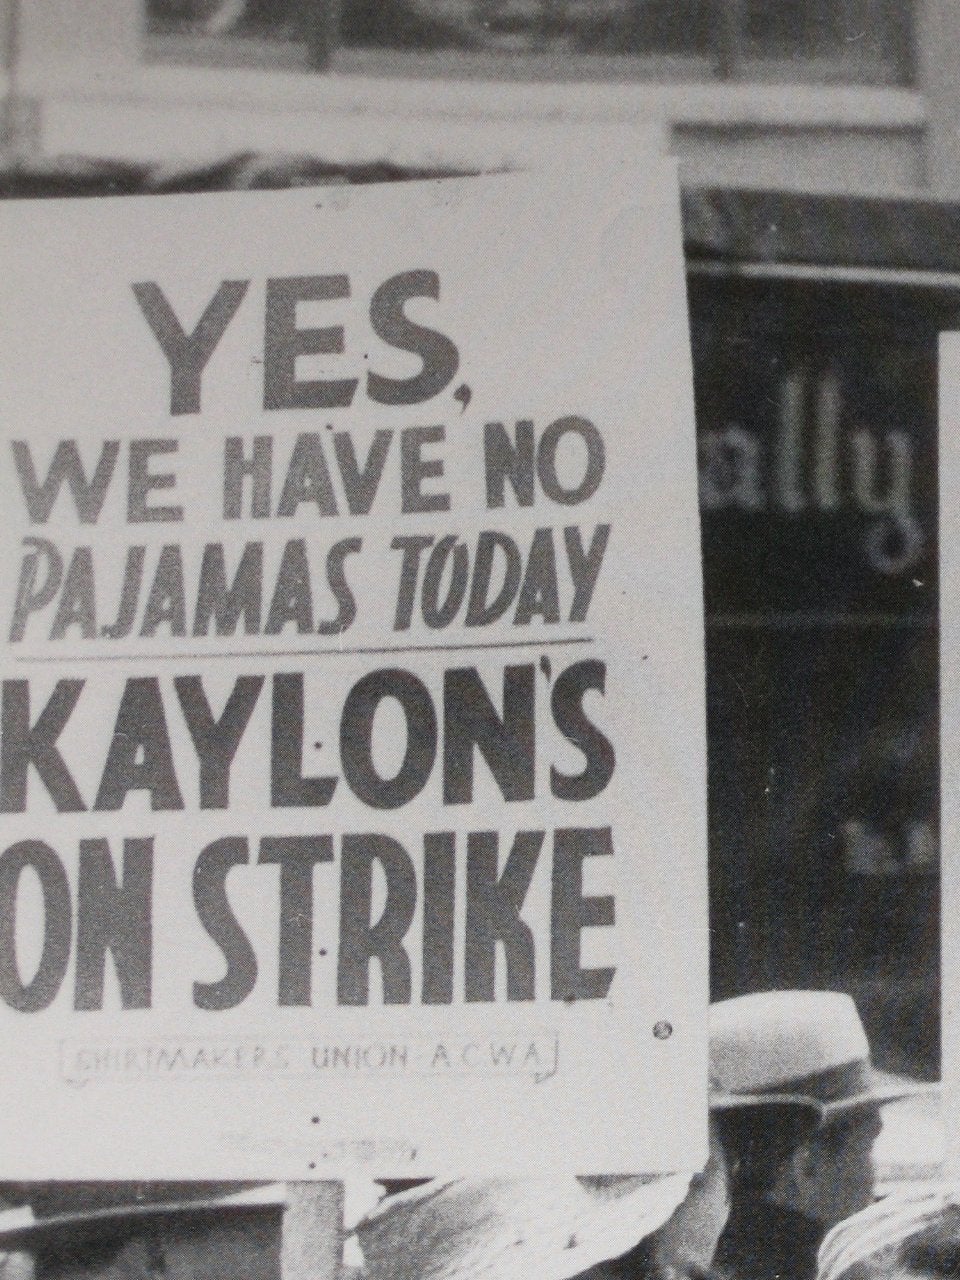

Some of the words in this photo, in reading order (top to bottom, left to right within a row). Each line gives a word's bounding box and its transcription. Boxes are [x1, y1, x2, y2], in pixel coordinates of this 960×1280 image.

[128, 266, 475, 418] YES,
[9, 437, 186, 526] WE
[221, 424, 453, 521] HAVE
[483, 415, 607, 510] NO
[8, 535, 364, 644] PAJAMAS
[389, 524, 612, 633] TODAY
[0, 656, 618, 815] KAYLON'S
[0, 834, 156, 1013] ON
[190, 826, 618, 1012] STRIKE
[310, 1043, 409, 1070] UNION
